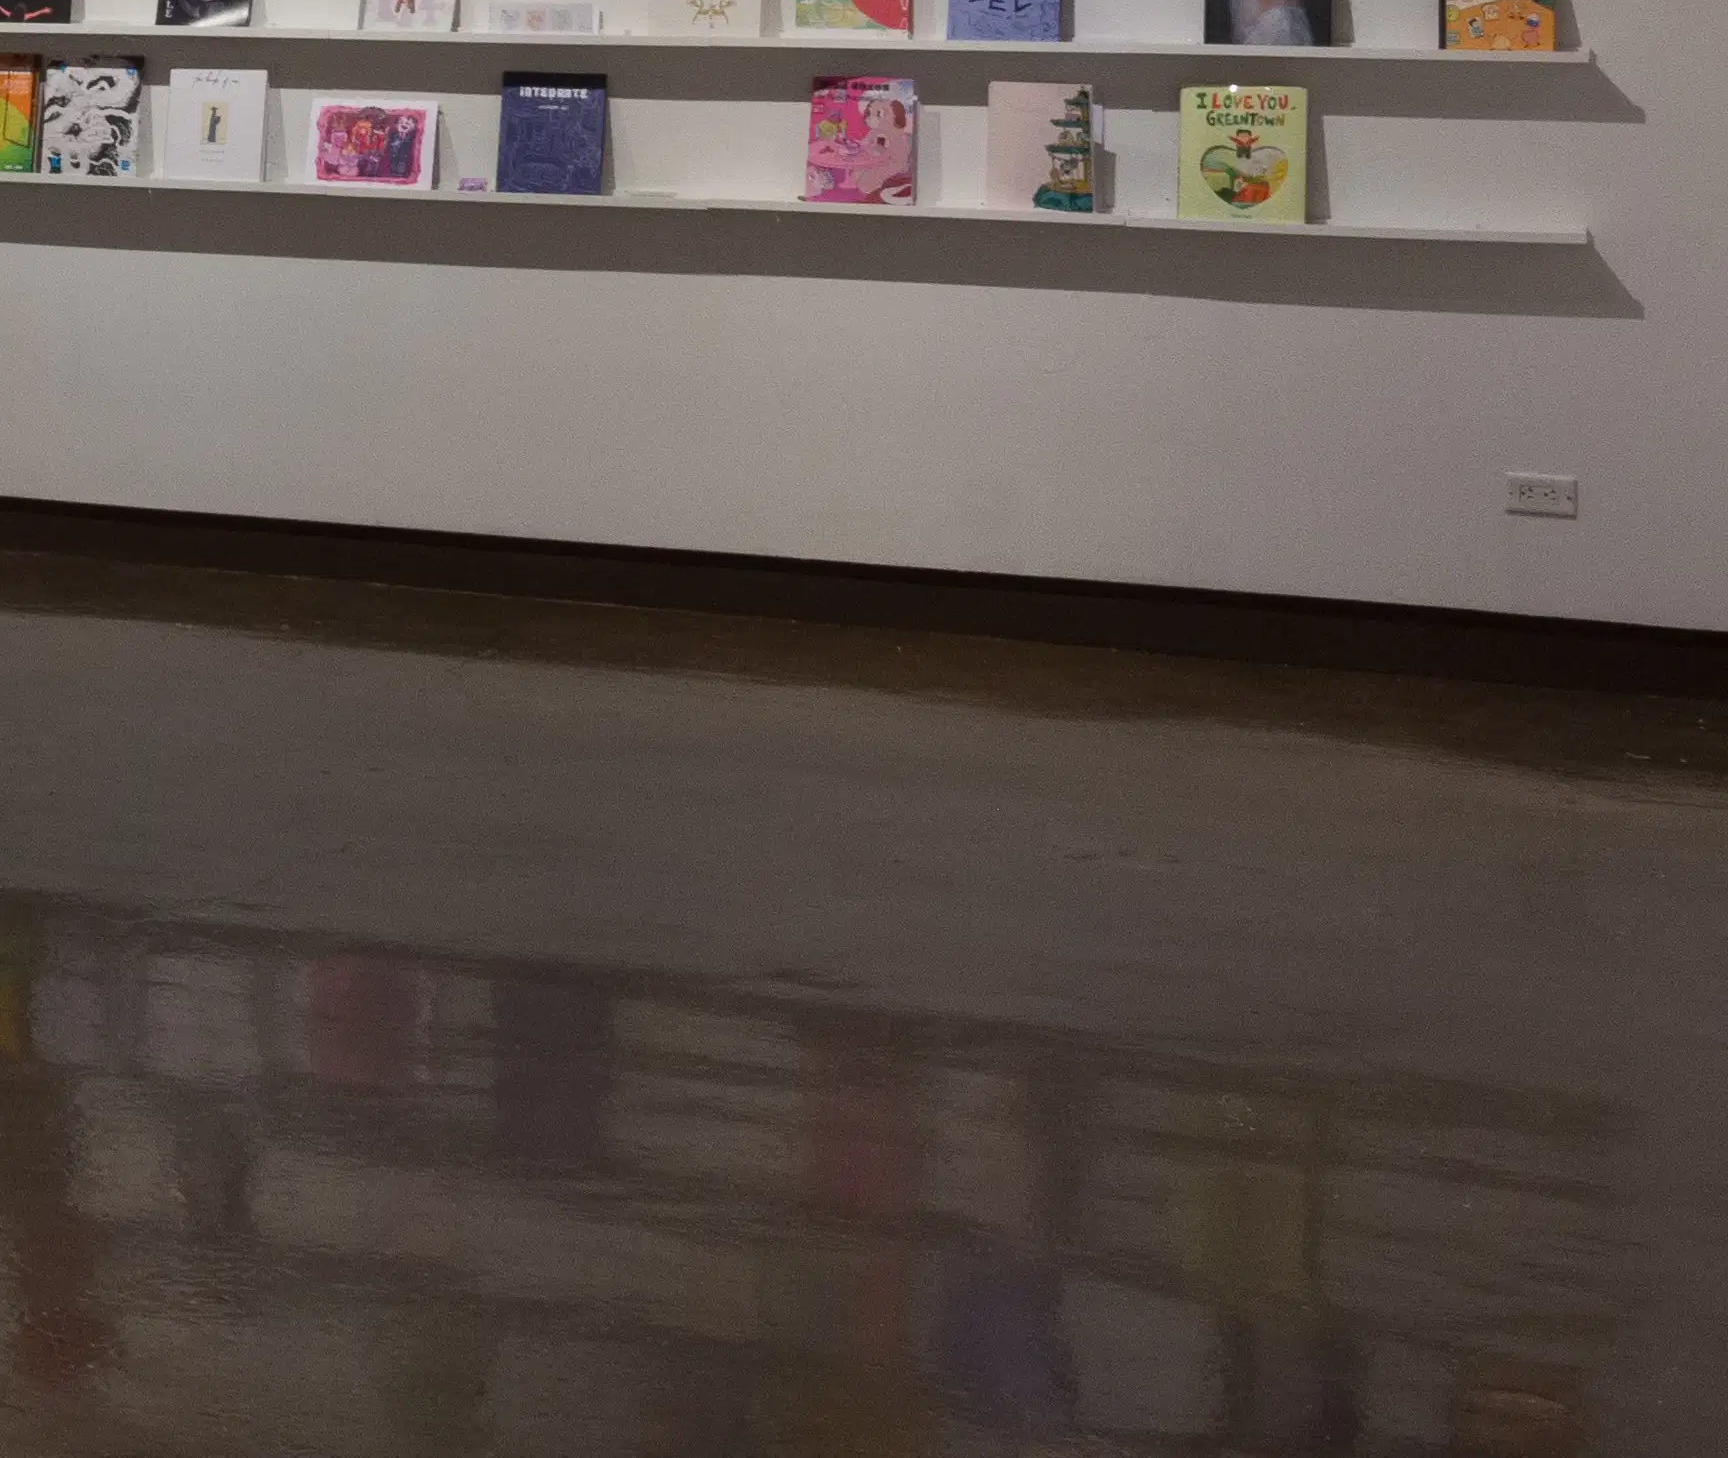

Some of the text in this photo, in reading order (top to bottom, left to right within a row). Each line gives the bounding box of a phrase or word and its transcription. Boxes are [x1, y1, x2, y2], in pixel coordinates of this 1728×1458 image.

[1196, 92, 1207, 110] I
[1211, 93, 1255, 110] LOVE
[1205, 110, 1286, 127] GREENTOWN
